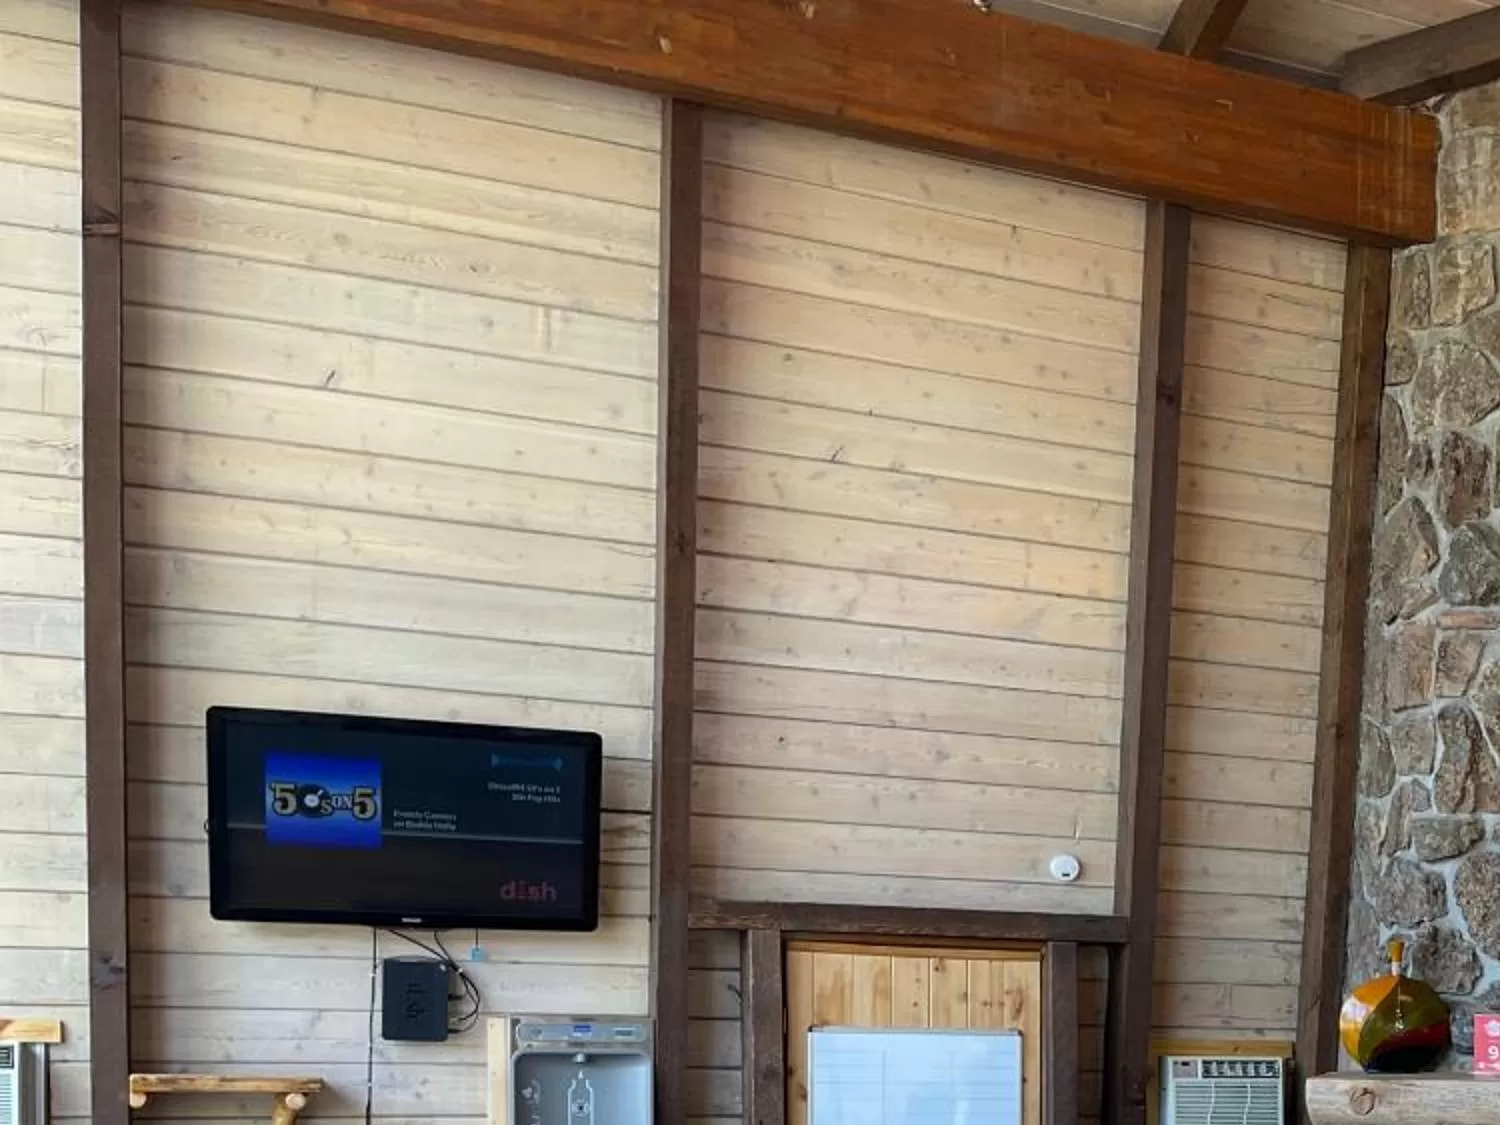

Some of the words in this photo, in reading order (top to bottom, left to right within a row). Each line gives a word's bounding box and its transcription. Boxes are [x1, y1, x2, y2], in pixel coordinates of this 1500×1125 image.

[353, 786, 376, 819] 5
[500, 879, 557, 901] dish
[1487, 1044, 1500, 1061] 9
